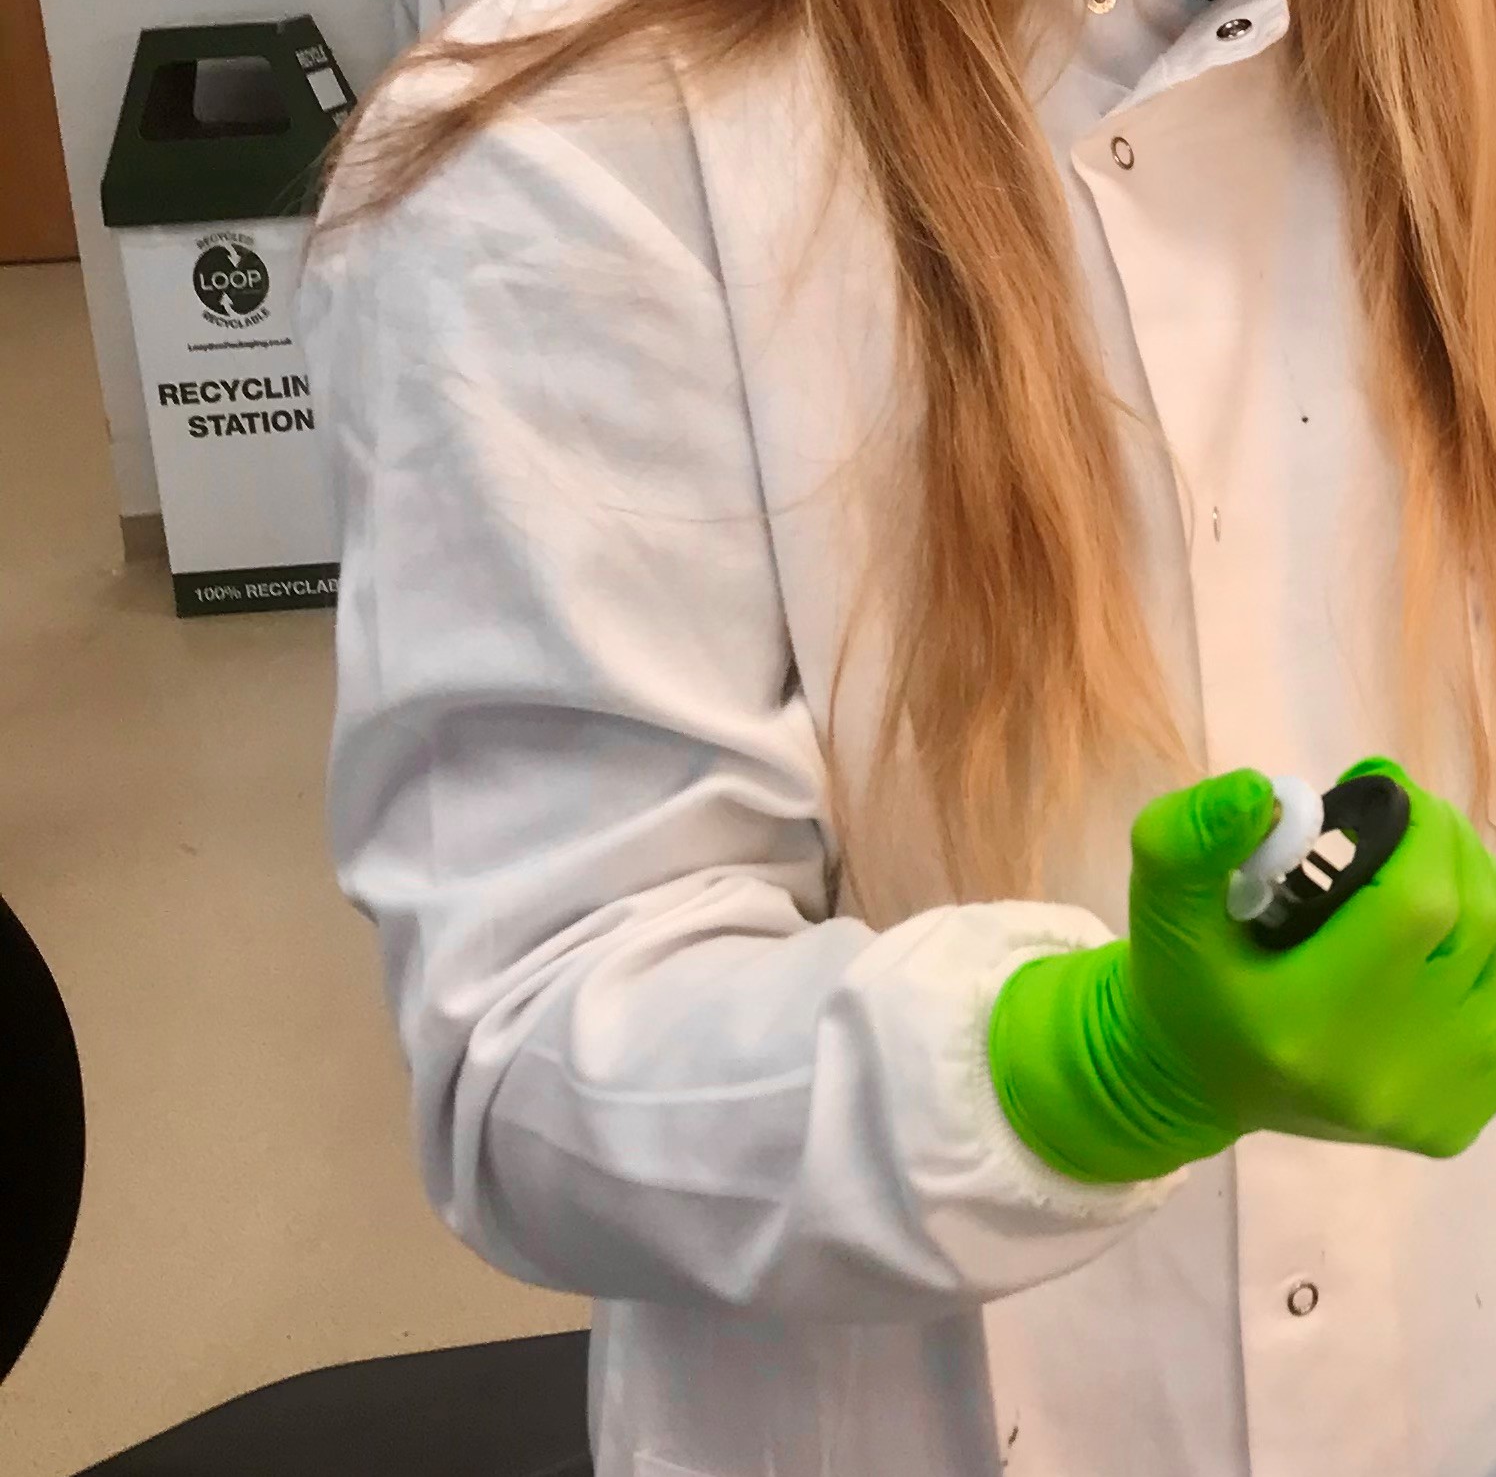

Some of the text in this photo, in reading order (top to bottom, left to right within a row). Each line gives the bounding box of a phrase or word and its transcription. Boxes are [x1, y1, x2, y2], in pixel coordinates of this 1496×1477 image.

[200, 269, 262, 291] LOOP
[158, 374, 311, 406] RECYCLIN
[188, 408, 315, 438] STATION
[195, 585, 242, 603] 100%
